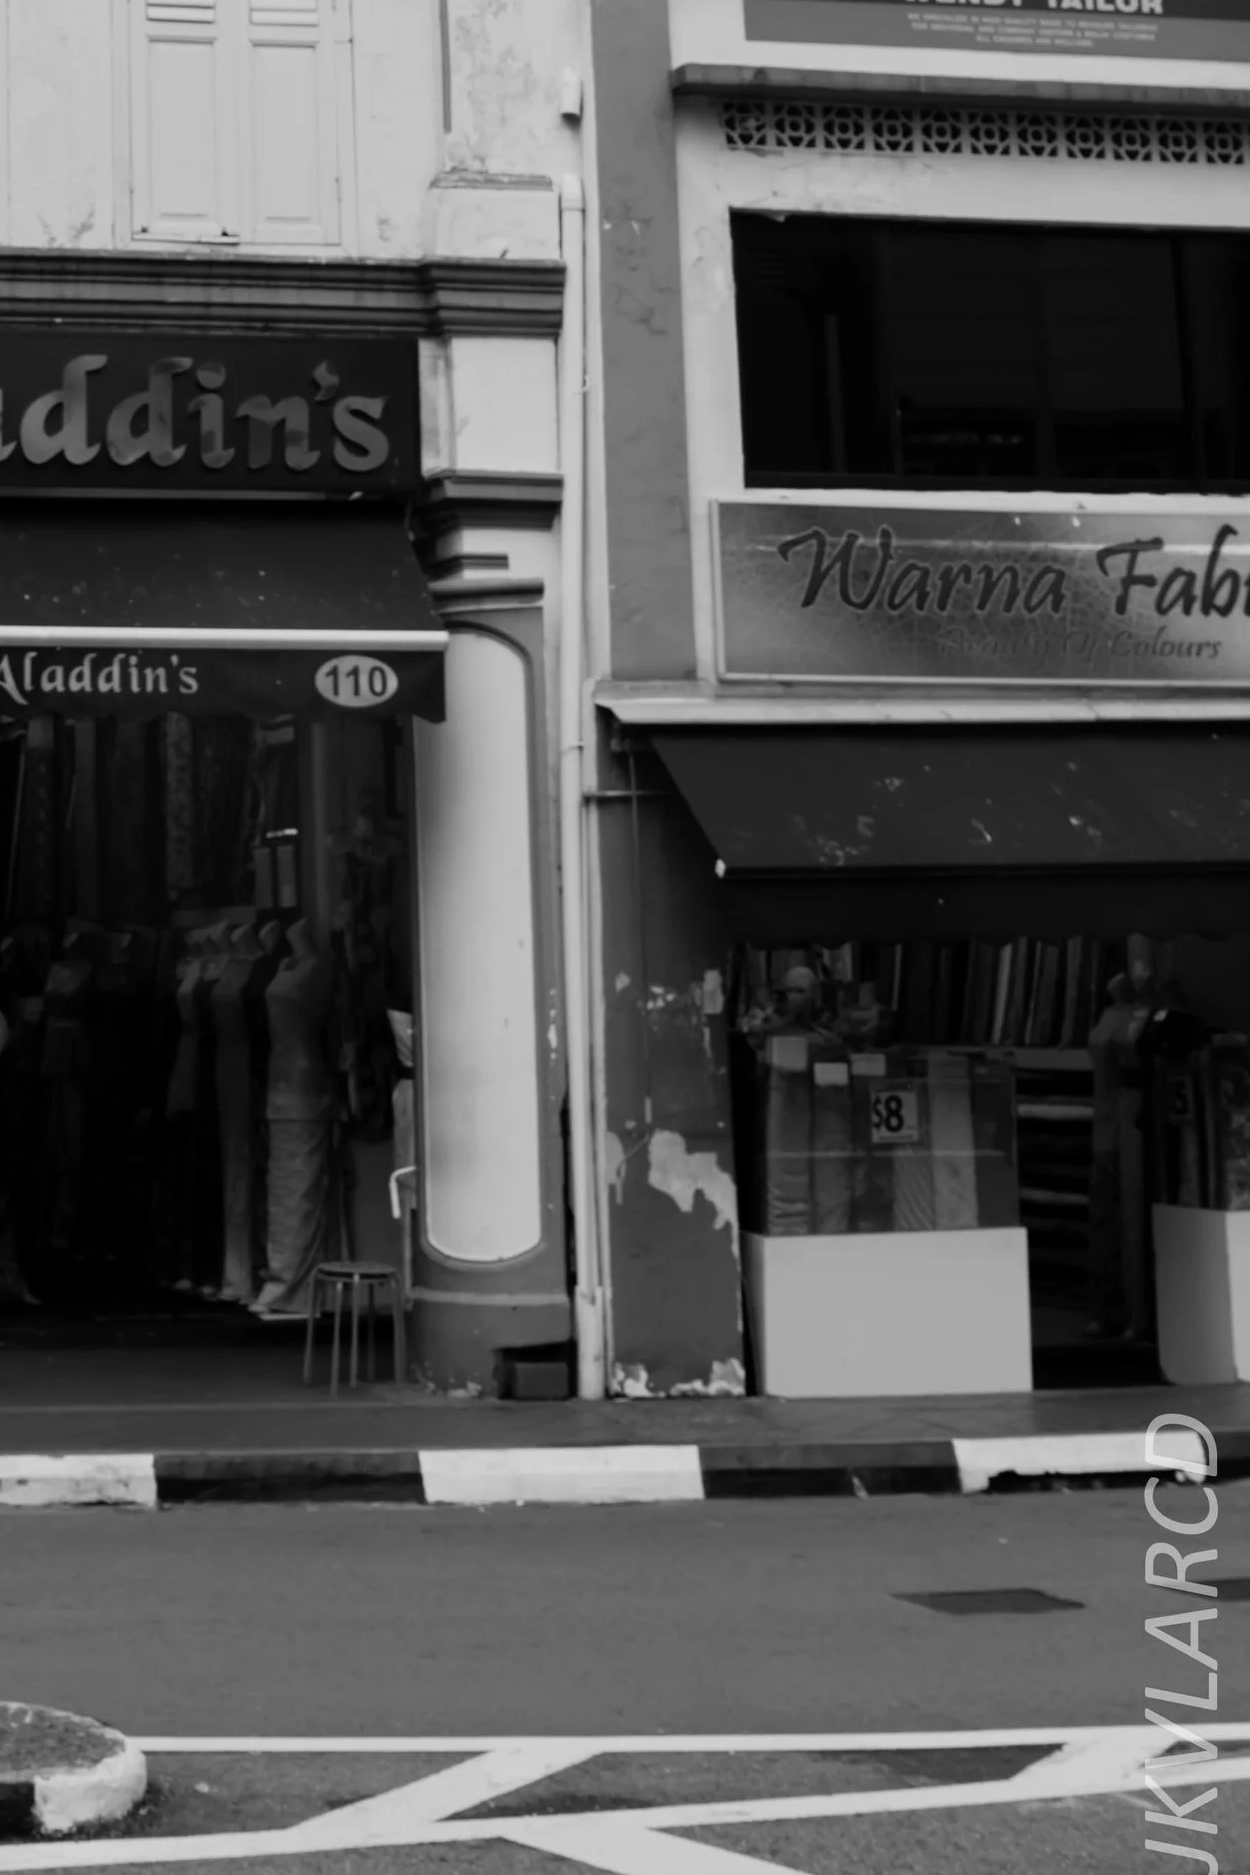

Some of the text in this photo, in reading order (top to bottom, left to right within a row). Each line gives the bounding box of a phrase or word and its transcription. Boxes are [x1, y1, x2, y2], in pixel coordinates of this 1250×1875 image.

[777, 524, 1250, 618] Warna Fab
[1111, 625, 1222, 659] Colours
[323, 665, 388, 699] 110
[872, 1095, 904, 1132] $8
